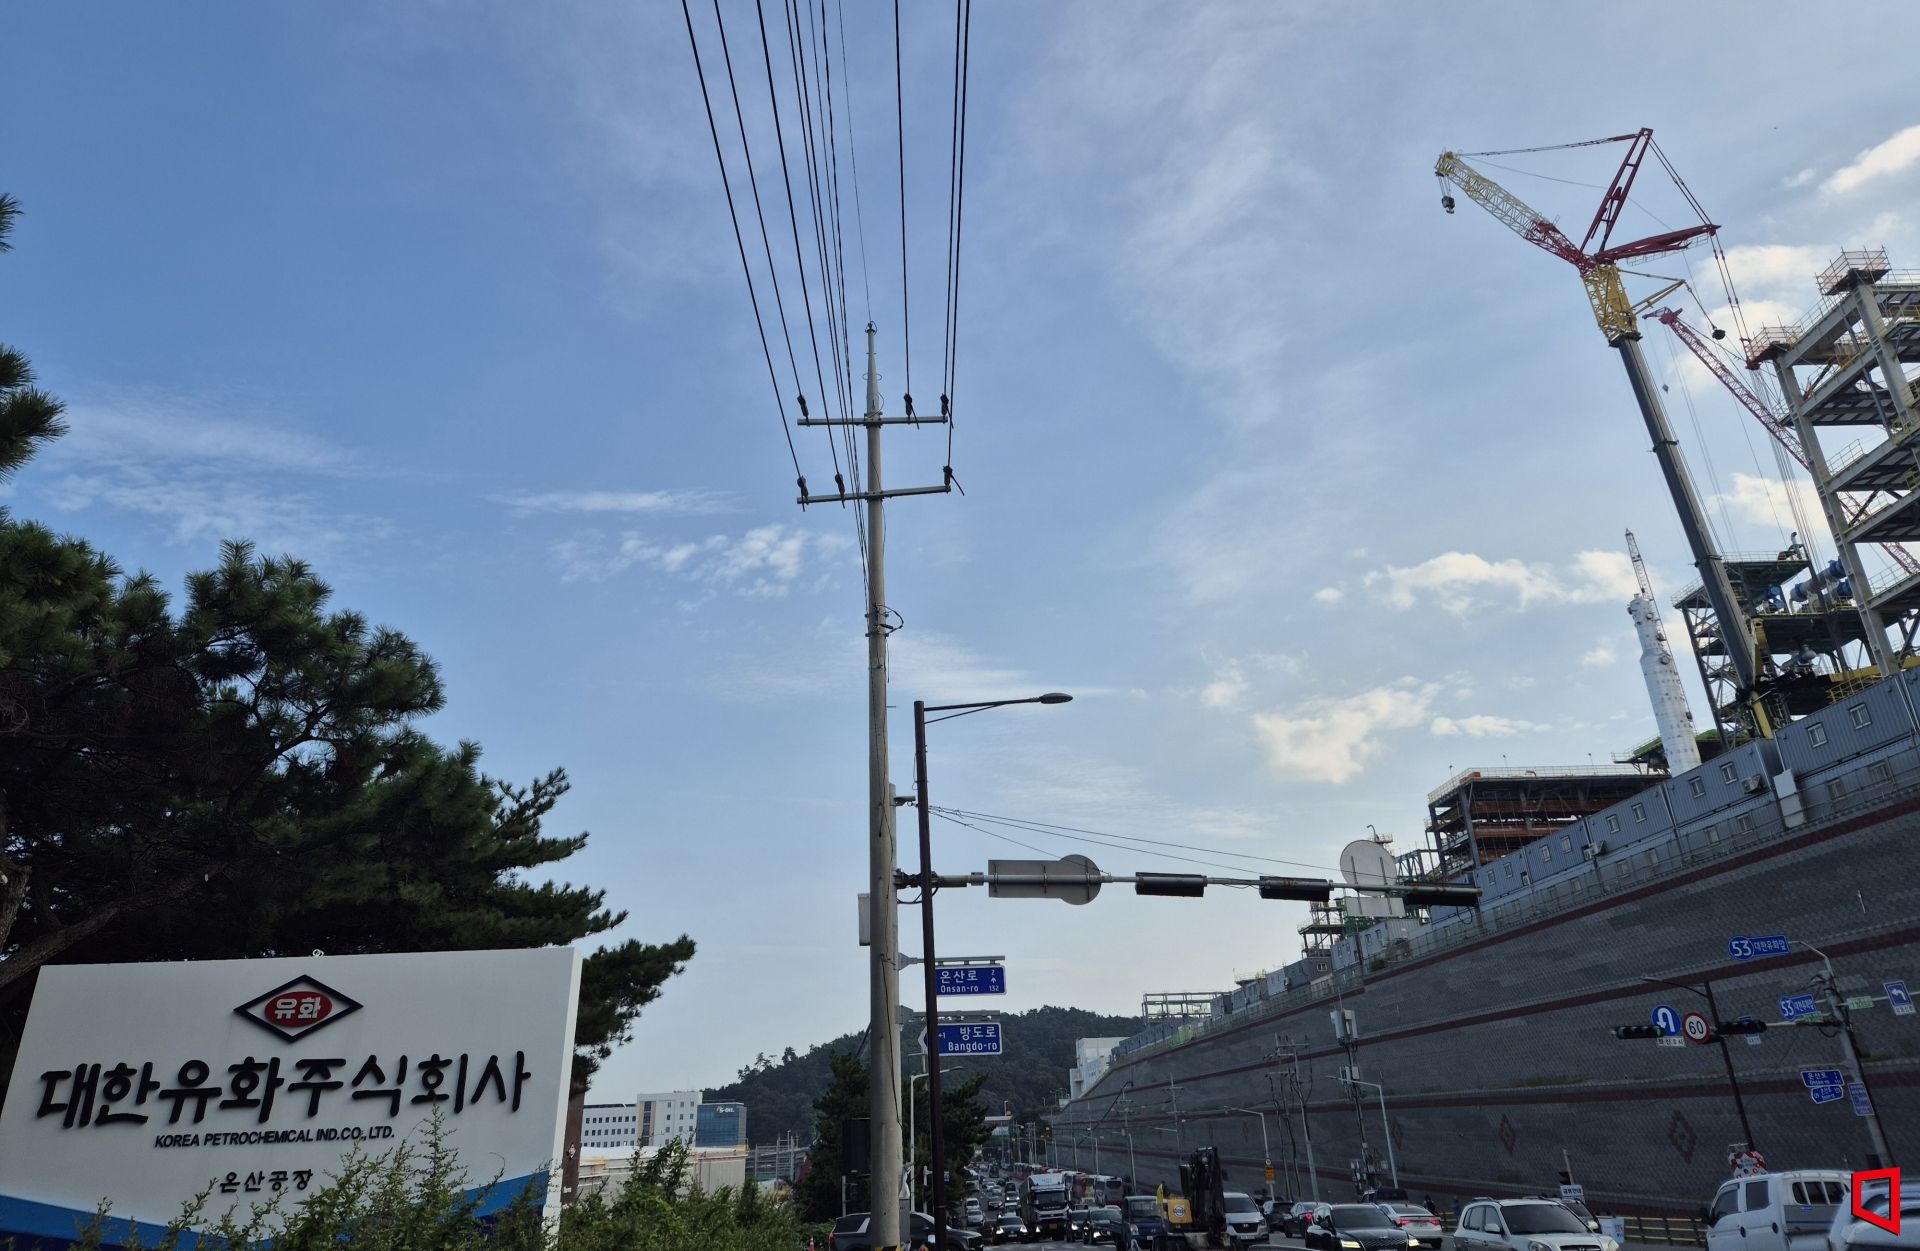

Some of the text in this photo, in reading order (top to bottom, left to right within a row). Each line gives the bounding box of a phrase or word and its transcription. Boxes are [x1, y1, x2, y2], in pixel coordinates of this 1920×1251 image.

[1731, 940, 1752, 957] 53
[940, 970, 978, 984] 온산로
[940, 985, 979, 993] Onsan-ro
[274, 996, 322, 1021] 유화
[960, 1026, 997, 1041] 방도로
[1688, 1021, 1704, 1035] 60
[948, 1041, 998, 1052] Bangdo-ro
[36, 1050, 532, 1129] 대한유화주식회사
[155, 1134, 199, 1148] KOREA
[203, 1129, 313, 1146] PETROCHEMICAL
[219, 1169, 313, 1193] 온산공장
